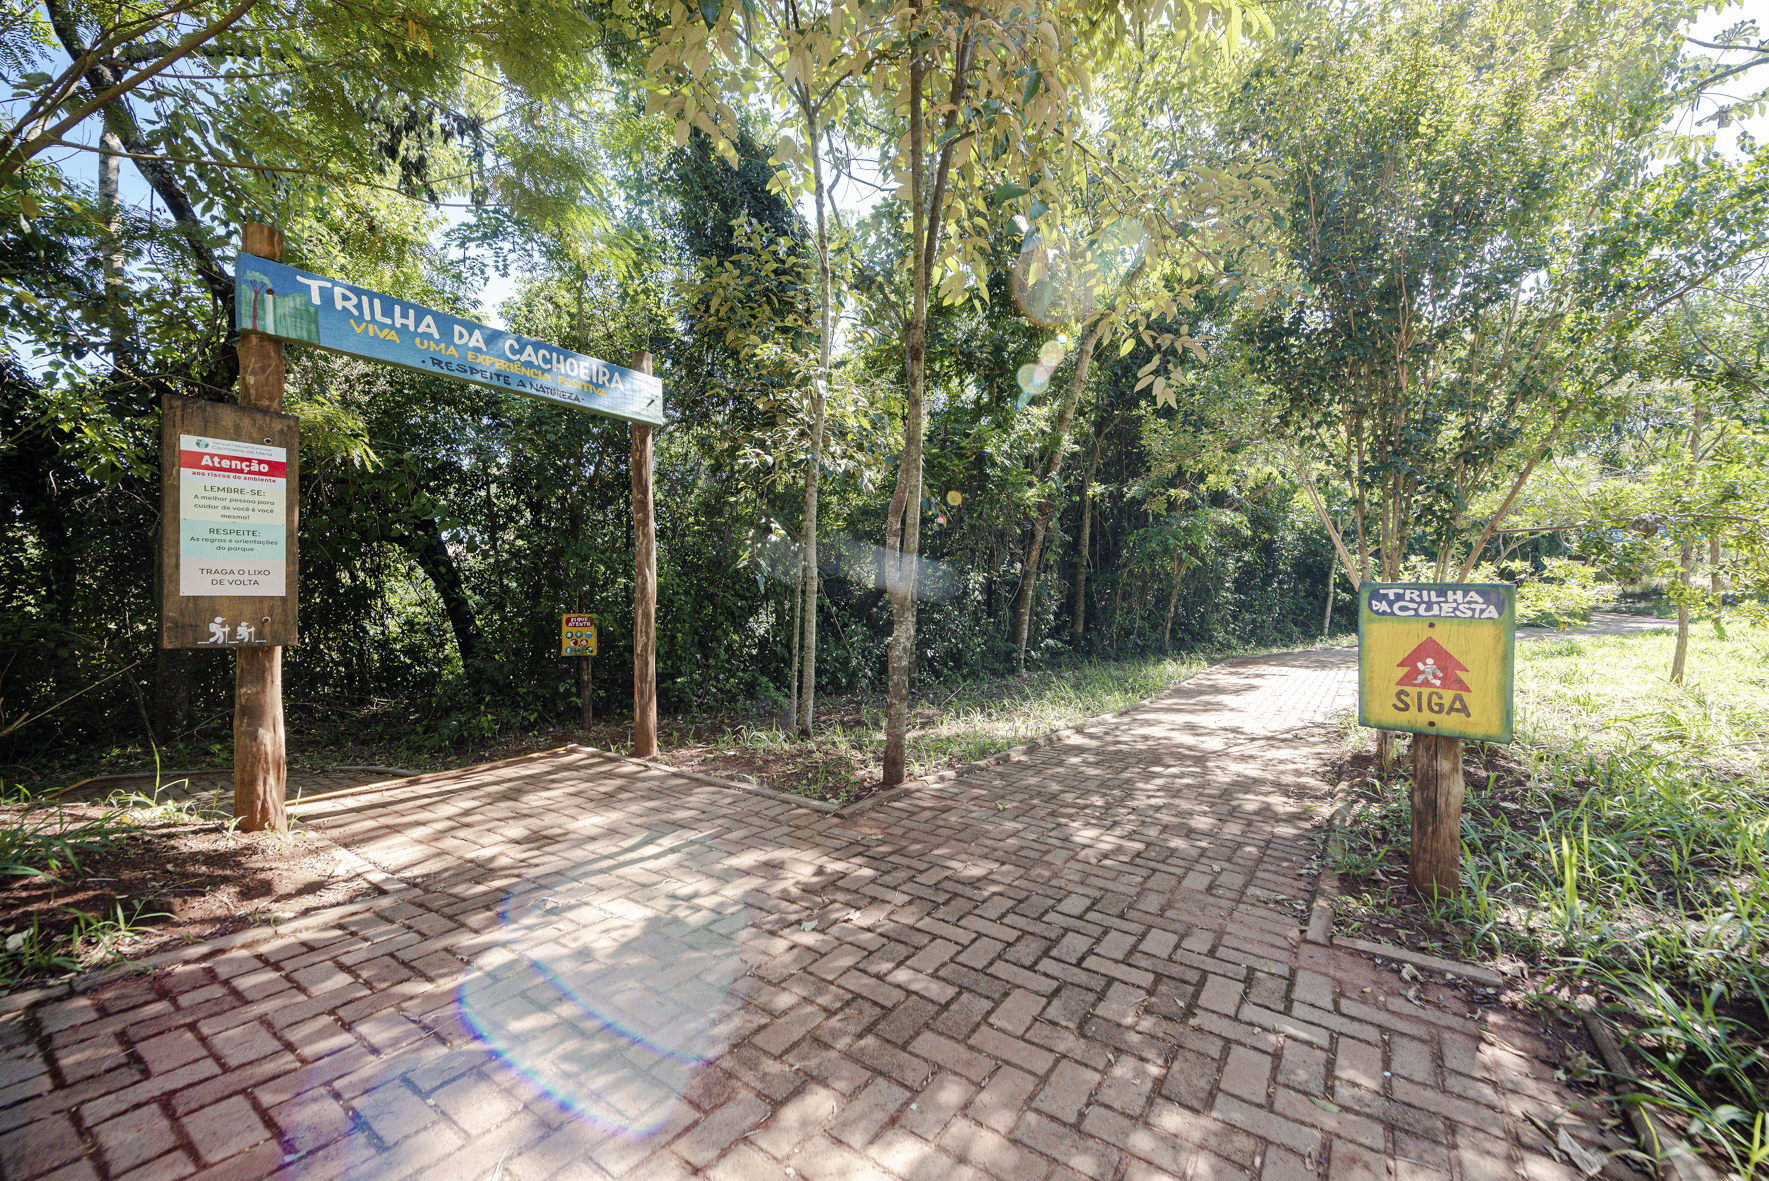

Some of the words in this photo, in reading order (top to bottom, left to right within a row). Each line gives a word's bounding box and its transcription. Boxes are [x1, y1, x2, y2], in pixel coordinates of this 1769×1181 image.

[296, 275, 439, 339] TRILHA
[453, 324, 487, 351] DA
[505, 339, 624, 391] CACHOEIRA
[350, 318, 400, 343] VIVA
[415, 337, 459, 358] UMA
[467, 351, 552, 382] EXPERIÊNCIA
[558, 376, 608, 398] POSITIVA
[516, 379, 527, 388] A
[211, 445, 245, 454] Cachoeira
[201, 455, 269, 473] Atenção
[207, 471, 231, 479] riscos
[243, 475, 276, 483] ambiente
[203, 485, 266, 497] LEMBRE-SE:
[208, 528, 261, 537] RESPEITE:
[199, 568, 236, 576] TRAGA
[211, 578, 225, 586] DE
[1379, 588, 1484, 604] TRILHA
[1371, 600, 1391, 613] DA
[1392, 601, 1500, 619] CUESTA
[1392, 688, 1472, 718] SIGA
